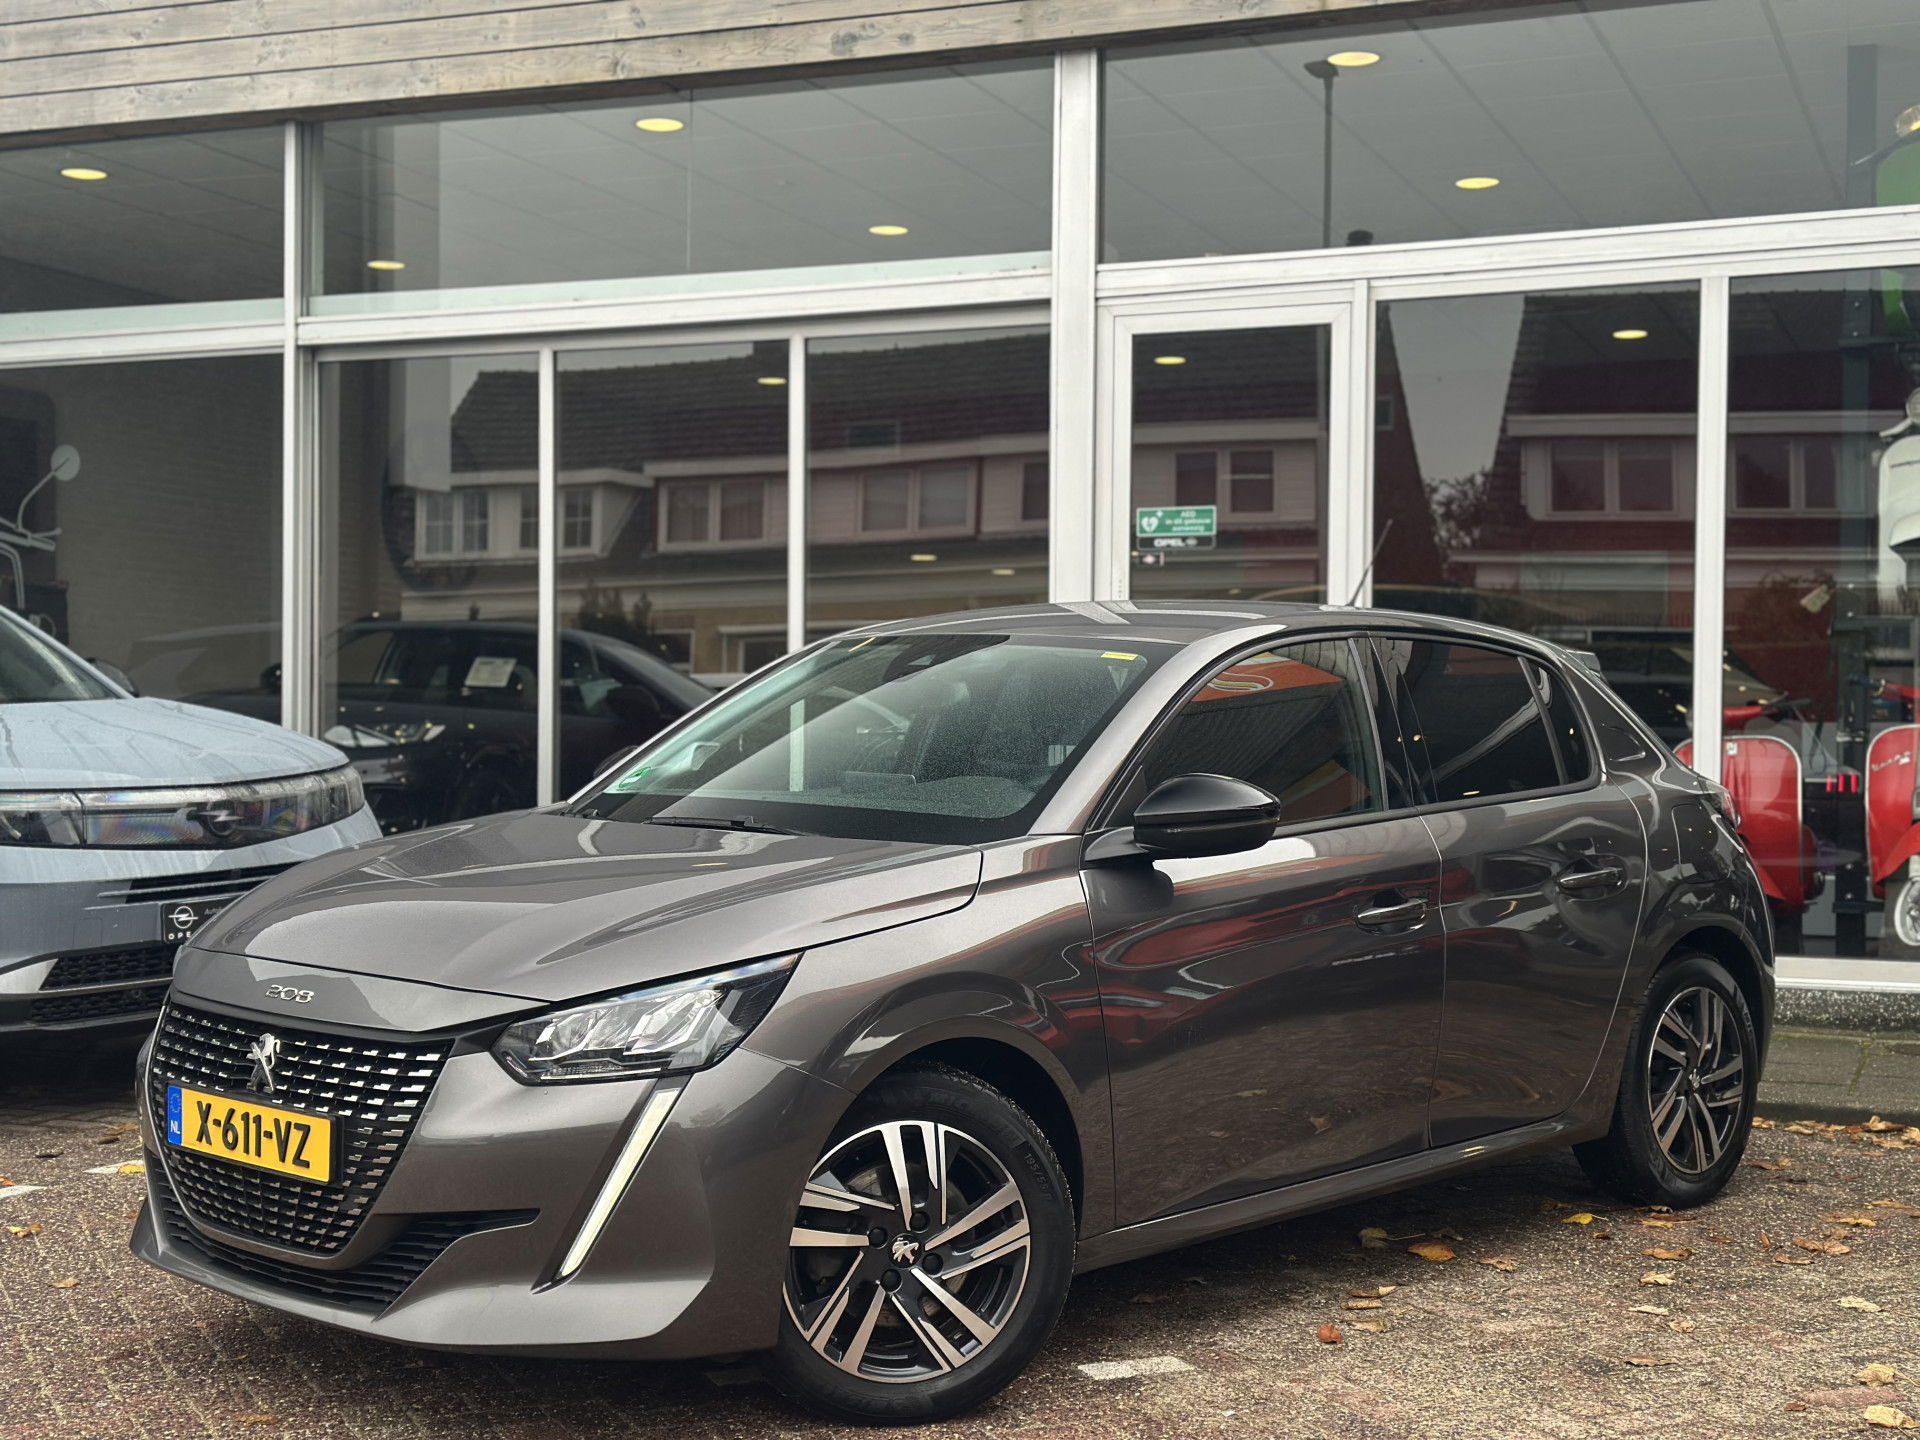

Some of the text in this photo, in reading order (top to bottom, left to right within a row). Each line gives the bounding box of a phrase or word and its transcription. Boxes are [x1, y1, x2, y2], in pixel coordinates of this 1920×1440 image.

[1153, 538, 1185, 547] OPEL
[168, 931, 192, 940] OPE
[265, 984, 315, 1003] 208
[170, 1121, 181, 1135] NL
[196, 1100, 311, 1169] X-611-VZ
